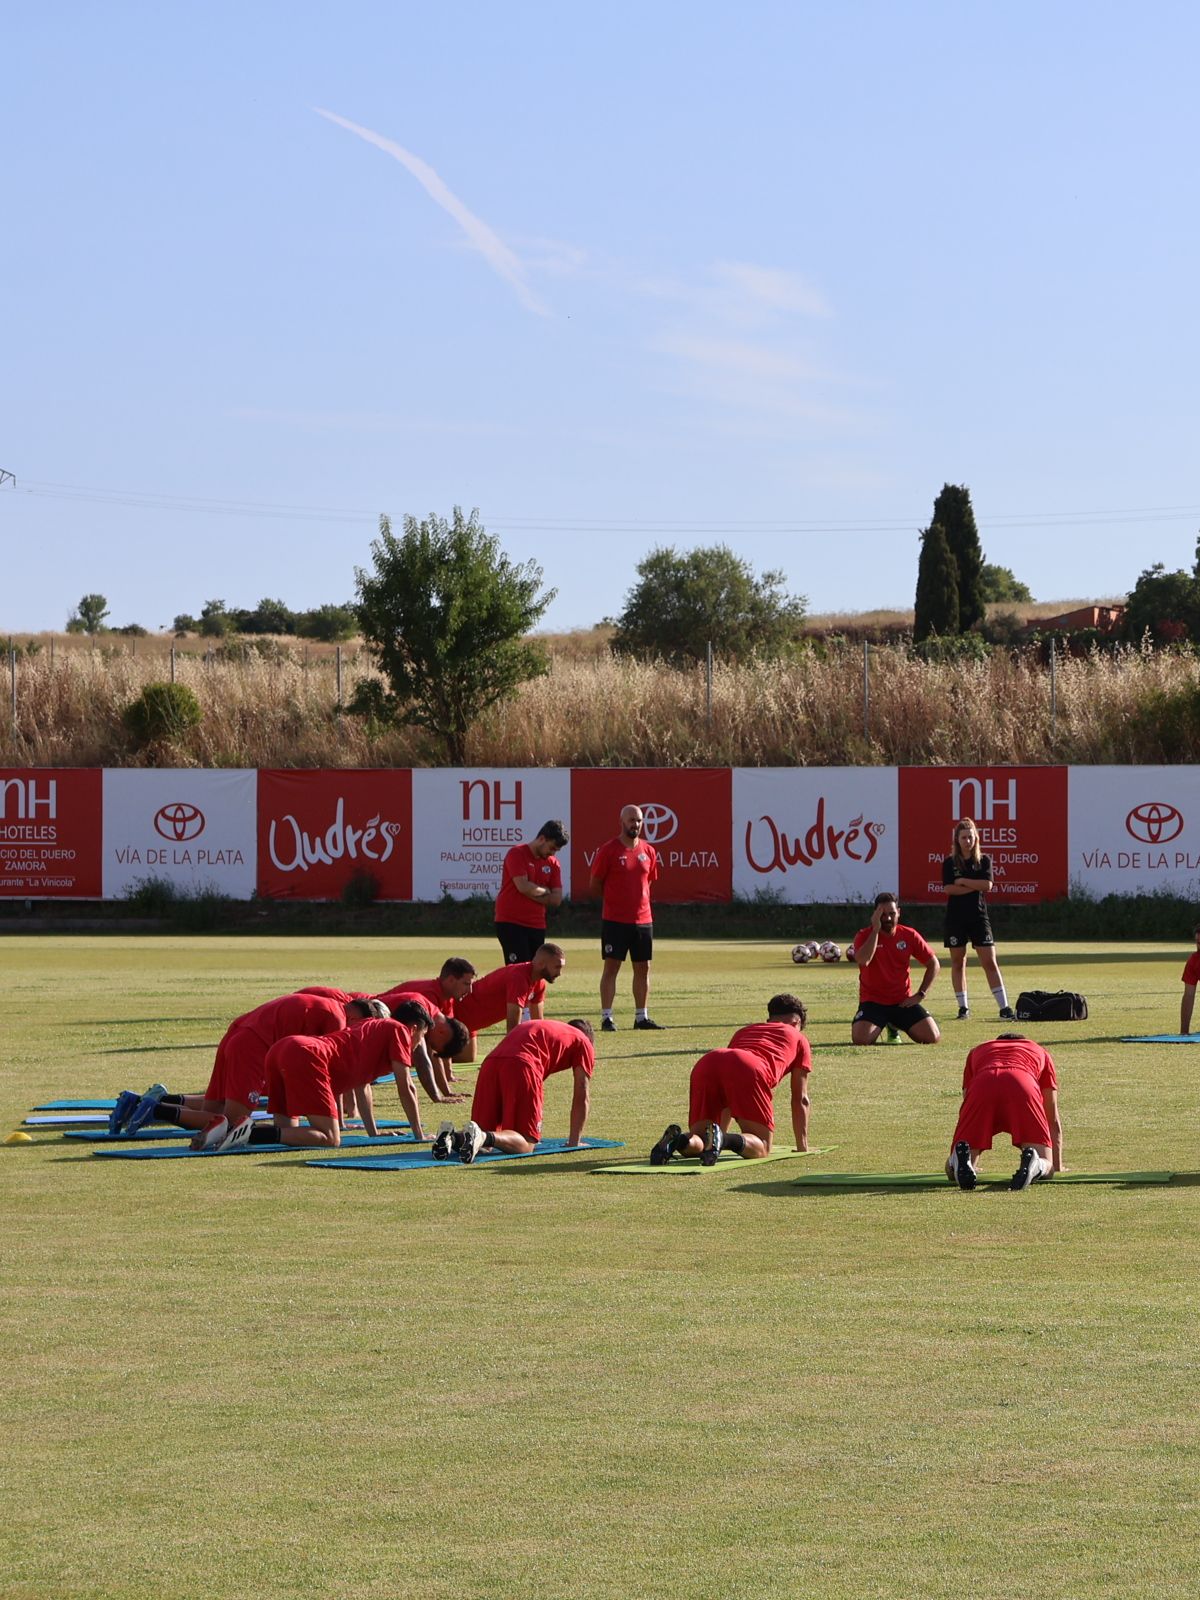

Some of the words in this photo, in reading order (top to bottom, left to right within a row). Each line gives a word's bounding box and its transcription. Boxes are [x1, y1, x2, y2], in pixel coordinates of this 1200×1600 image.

[462, 828, 523, 841] HOTELES
[20, 849, 38, 859] DEL
[40, 849, 76, 859] DUERO
[115, 845, 141, 865] VÍA
[146, 849, 167, 865] DE
[173, 849, 192, 865] LA
[197, 849, 244, 865] PLATA
[440, 852, 482, 862] PALACIO
[669, 851, 719, 867] PLATA
[999, 853, 1039, 863] DUERO
[1082, 849, 1111, 868] VÍA
[1117, 853, 1141, 868] DE
[1147, 853, 1168, 868] LA
[5, 861, 47, 871] ZAMORA
[440, 881, 490, 890] Restaurante
